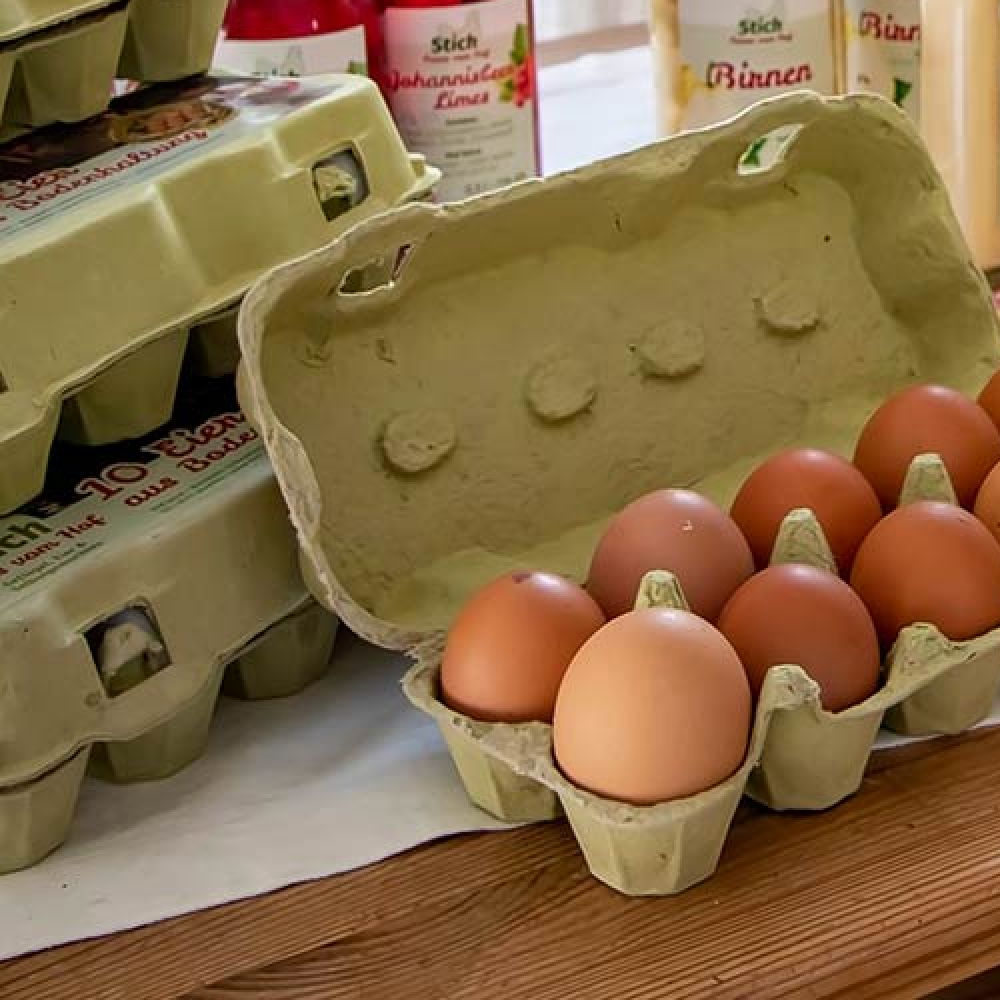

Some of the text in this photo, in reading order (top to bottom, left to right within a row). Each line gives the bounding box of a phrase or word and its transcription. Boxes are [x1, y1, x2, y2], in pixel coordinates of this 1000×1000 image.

[738, 16, 782, 35] Stich
[859, 10, 920, 41] Birn
[431, 31, 477, 53] Stich
[706, 60, 812, 88] Birnen
[434, 89, 489, 110] Limes
[79, 464, 149, 500] 10
[154, 412, 247, 458] Eier
[124, 477, 179, 507] aus
[177, 428, 259, 473] Bode
